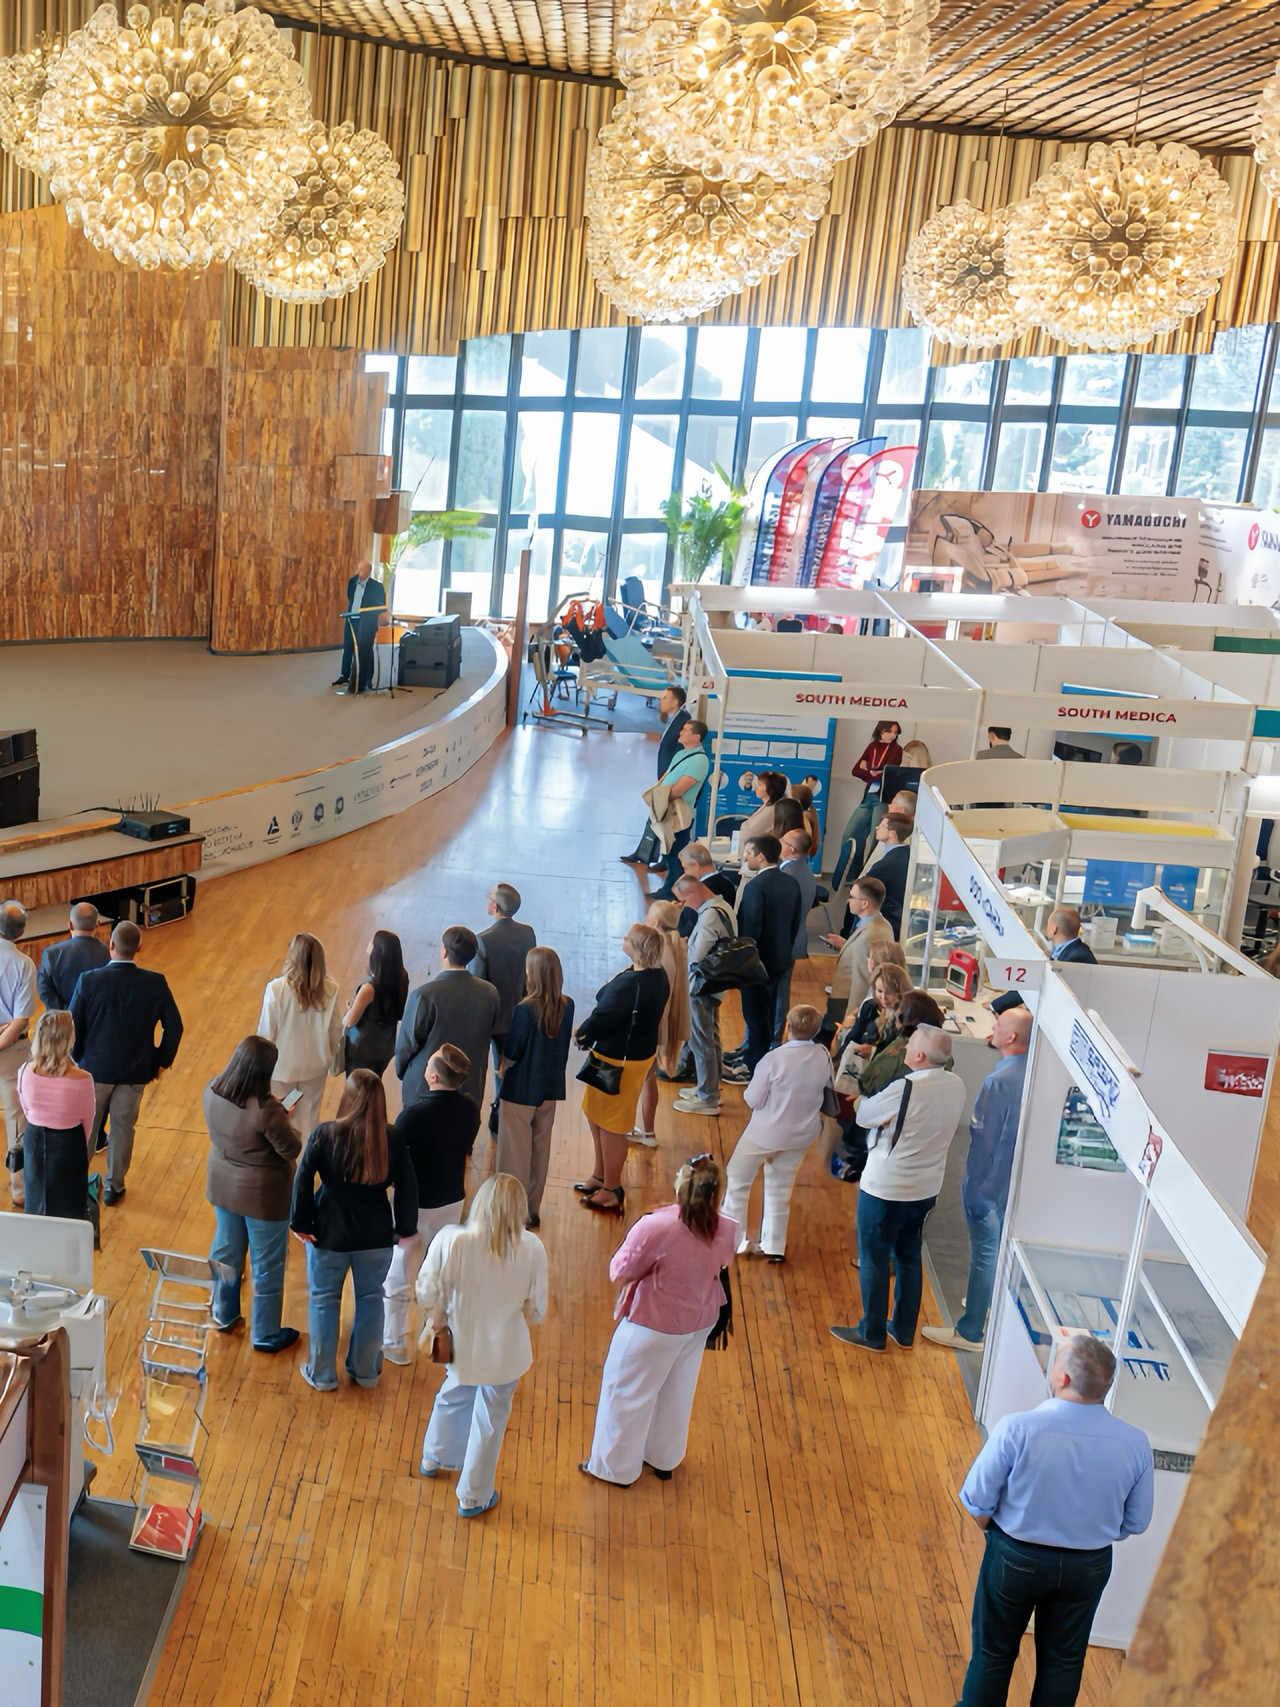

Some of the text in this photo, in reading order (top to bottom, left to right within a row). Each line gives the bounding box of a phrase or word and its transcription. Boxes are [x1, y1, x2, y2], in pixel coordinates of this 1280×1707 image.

[1107, 513, 1187, 528] YAMAGUCHI
[795, 693, 908, 709] SOUTH MEDICA
[1058, 706, 1177, 723] SOUTH MEDICA
[1005, 966, 1027, 983] 12
